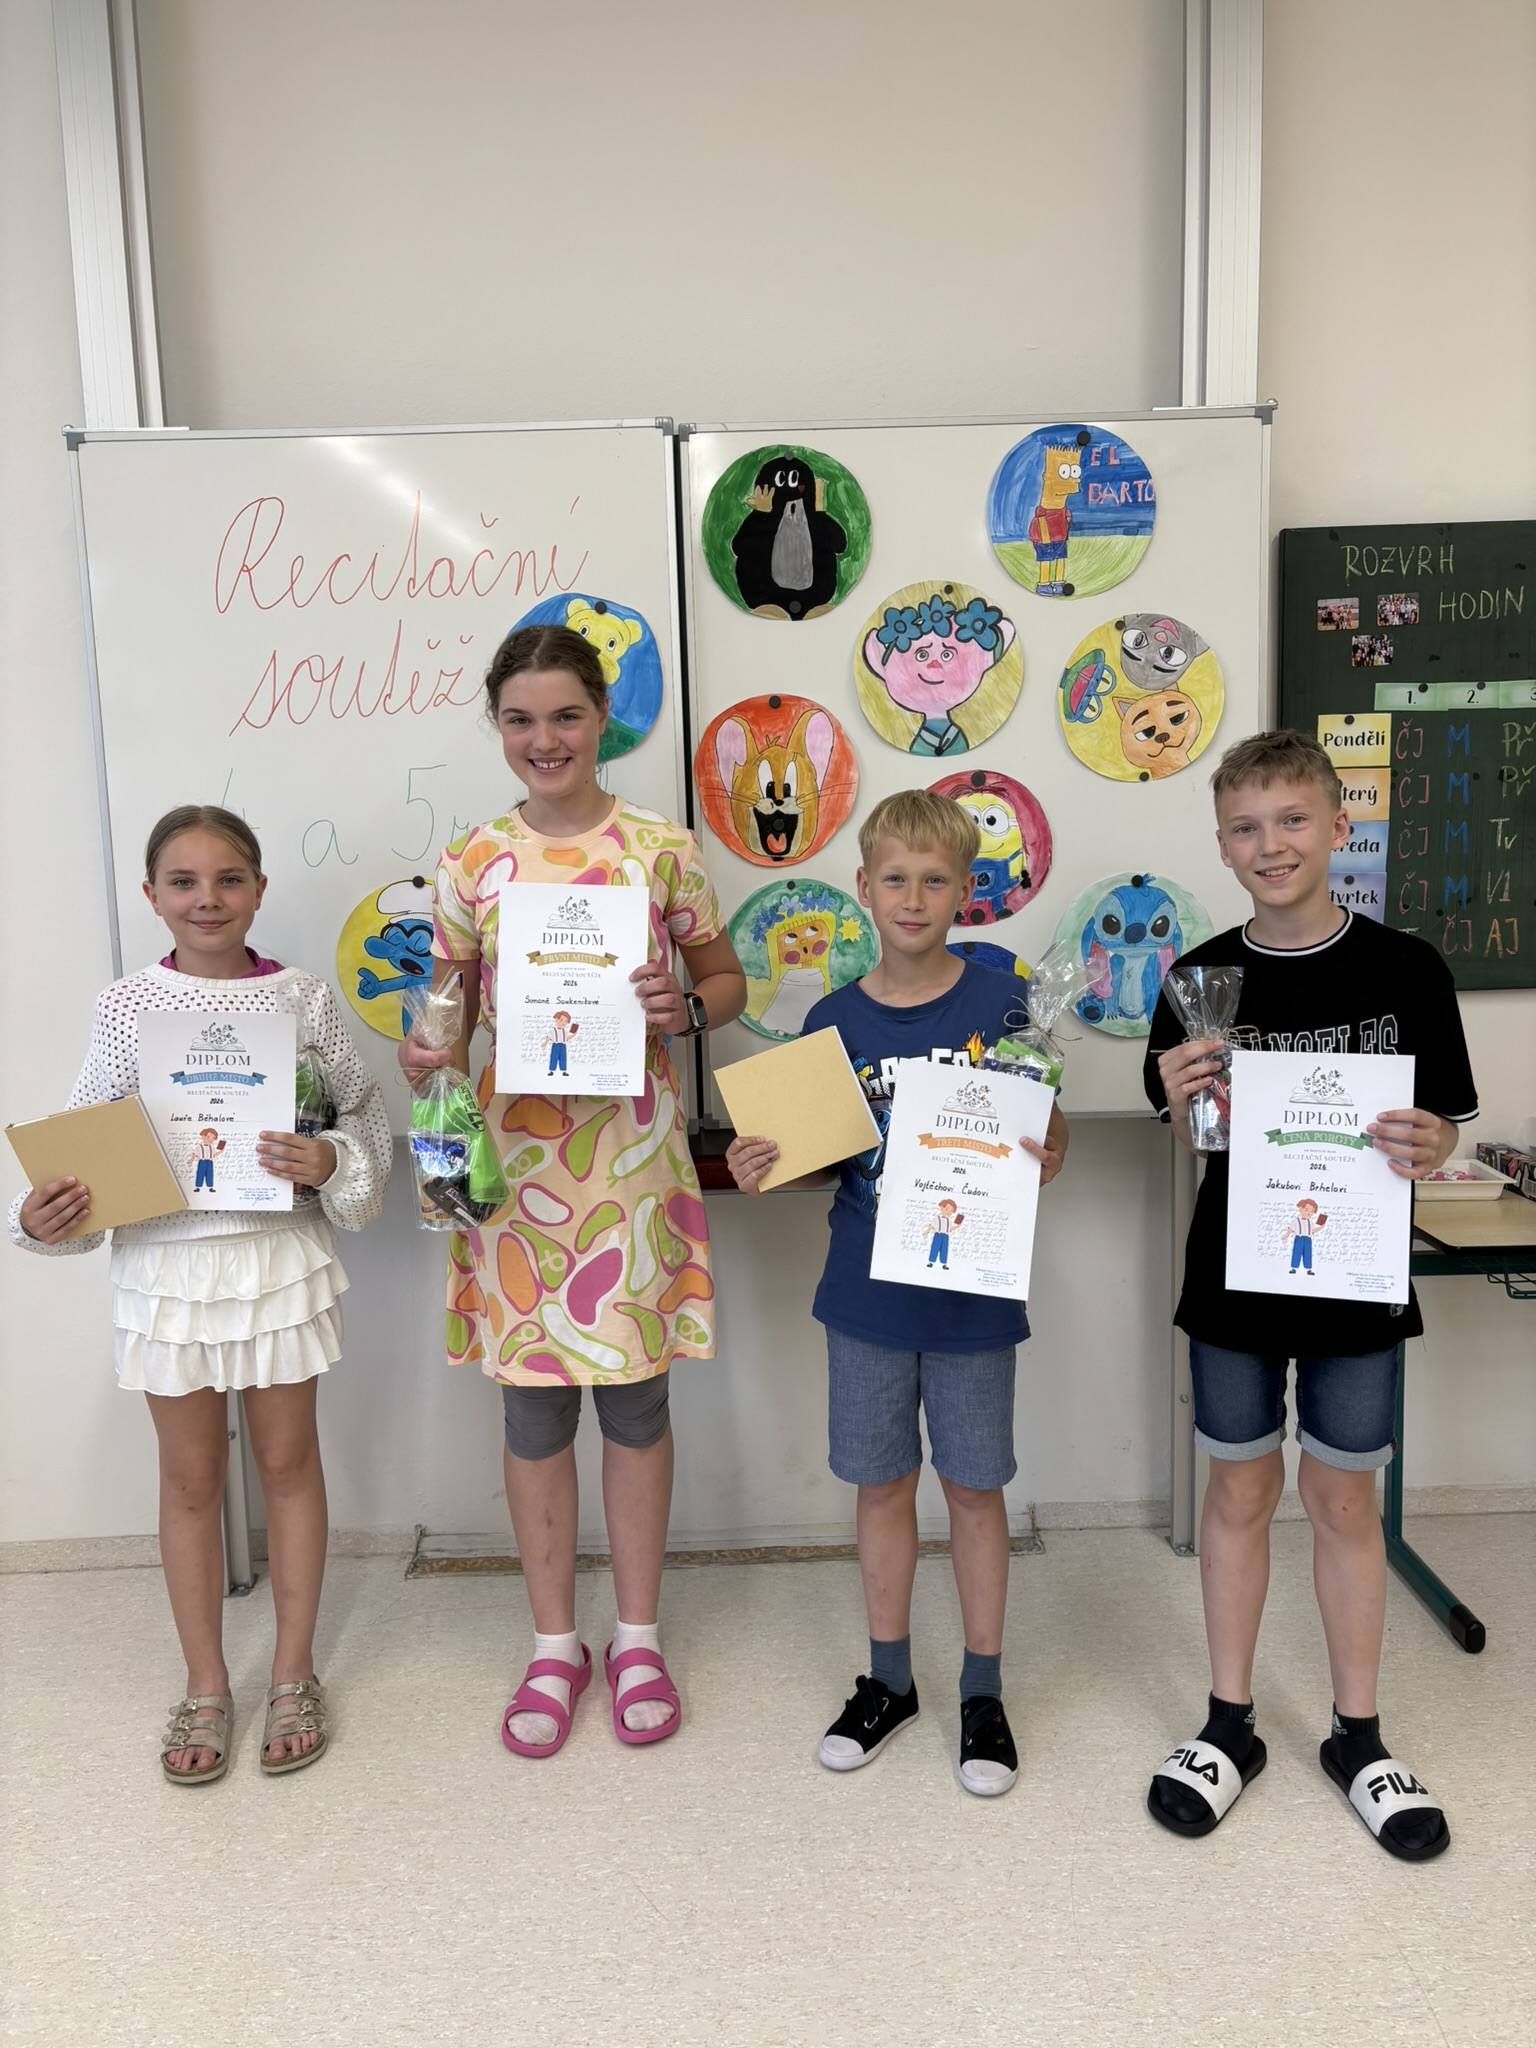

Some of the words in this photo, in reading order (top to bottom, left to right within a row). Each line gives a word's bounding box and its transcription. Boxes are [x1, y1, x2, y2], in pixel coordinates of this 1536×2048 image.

[214, 489, 590, 613] Recitační
[1341, 544, 1454, 579] ROZVRH
[1439, 585, 1525, 623] HODIN
[229, 619, 487, 736] soutěž
[1407, 690, 1417, 705] 1.
[1467, 689, 1480, 704] 2.
[1323, 731, 1386, 747] Pondělí
[1395, 718, 1424, 760] ČJ
[1447, 721, 1471, 758] M
[1342, 786, 1377, 806] terý
[1399, 768, 1430, 808] ČJ
[1447, 771, 1471, 807] M
[302, 819, 359, 868] a
[1398, 819, 1429, 860] ČJ
[1443, 819, 1470, 855] M
[1488, 817, 1518, 850] Tv
[1328, 889, 1379, 905] tvrtek
[1399, 871, 1429, 915] ČJ
[1442, 874, 1470, 912] M
[542, 932, 604, 947] DIPLOM
[1442, 914, 1473, 956] ČJ
[1483, 917, 1519, 959] AJ
[186, 1054, 251, 1066] DIPLOM
[935, 1114, 1001, 1136] DIPLOM
[1283, 1110, 1359, 1127] DIPLOM
[1283, 1132, 1310, 1143] CENA
[1314, 1132, 1357, 1147] POROTY
[1309, 1162, 1327, 1171] 2026
[914, 1178, 954, 1193] Vojtěchovi
[961, 1182, 989, 1198] Čudovi
[1265, 1178, 1302, 1191] Jakubovi
[1309, 1181, 1348, 1194] Brhelovi
[1163, 1748, 1219, 1786] FILA
[1366, 1771, 1430, 1804] FILA
